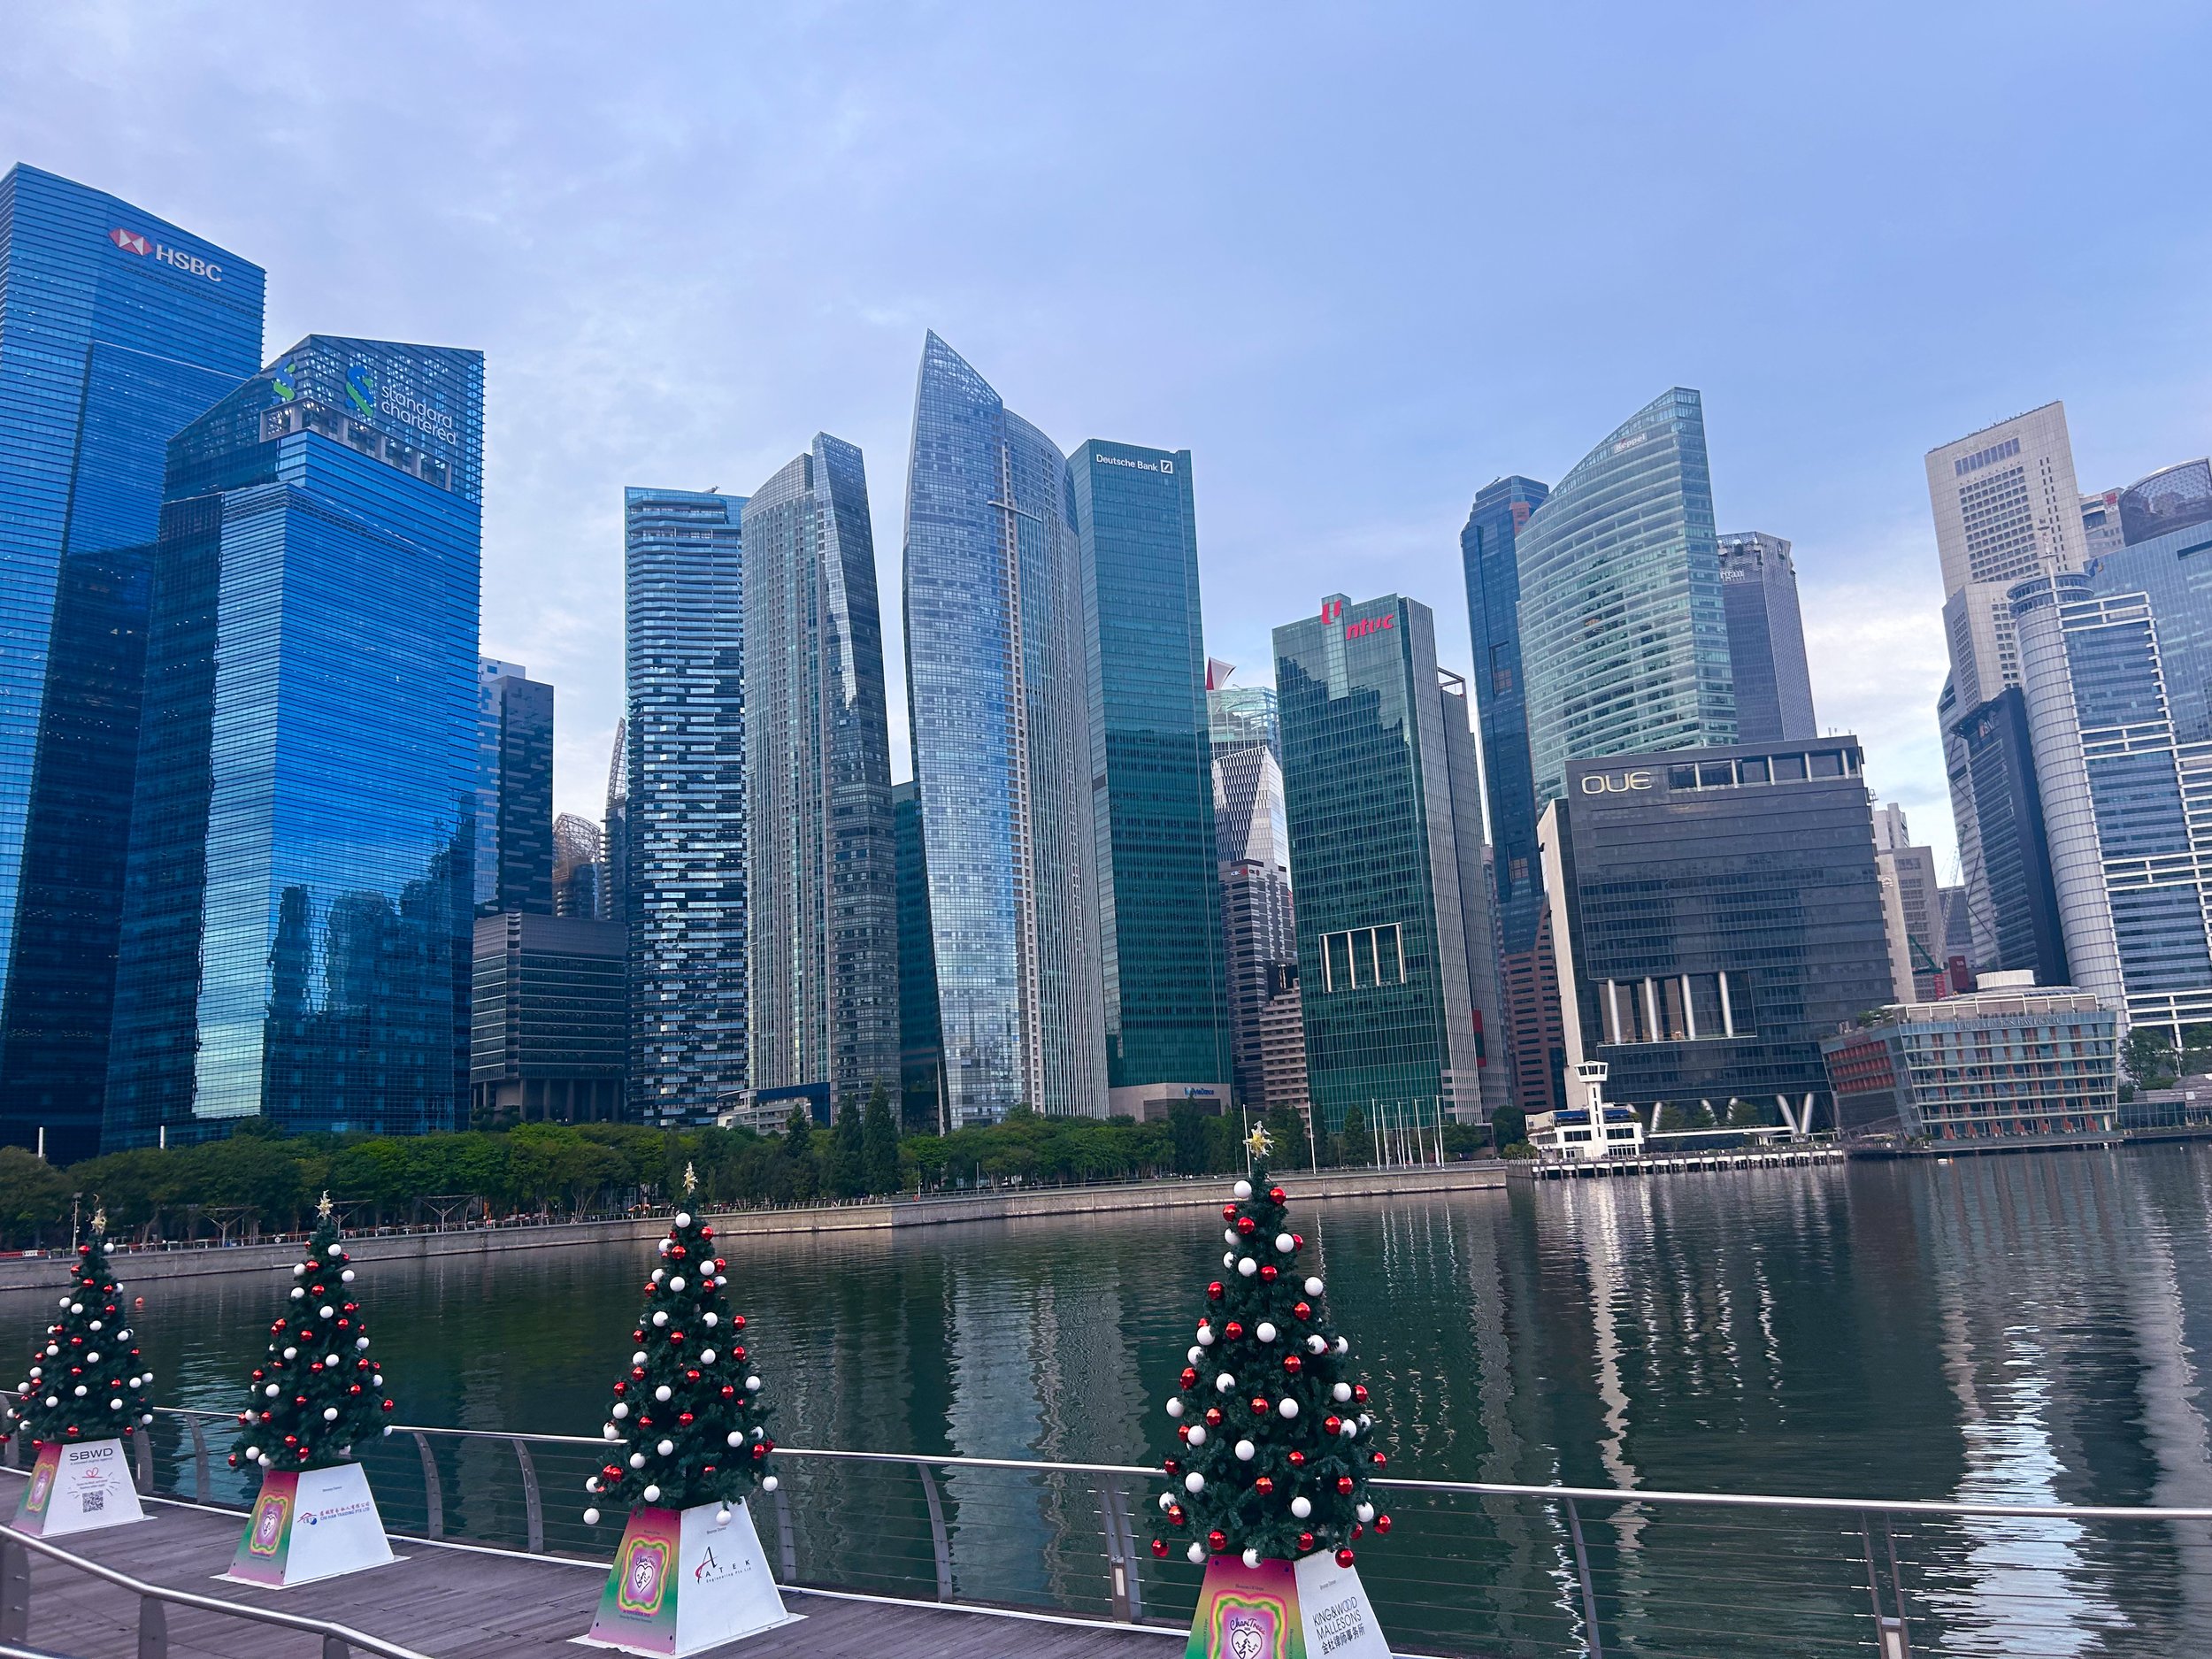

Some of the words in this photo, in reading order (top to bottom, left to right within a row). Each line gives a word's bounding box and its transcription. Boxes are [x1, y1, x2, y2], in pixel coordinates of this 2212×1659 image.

[156, 242, 223, 282] HSBC
[381, 385, 453, 429] standard
[381, 400, 457, 445] chartered
[1615, 433, 1646, 452] Keppel
[1096, 453, 1135, 469] Deutsche
[1137, 460, 1159, 472] Bank
[1346, 614, 1394, 641] ntuc
[1581, 772, 1653, 795] OUE
[69, 1448, 113, 1462] SBWD
[1316, 1609, 1362, 1641] MALLESONS
